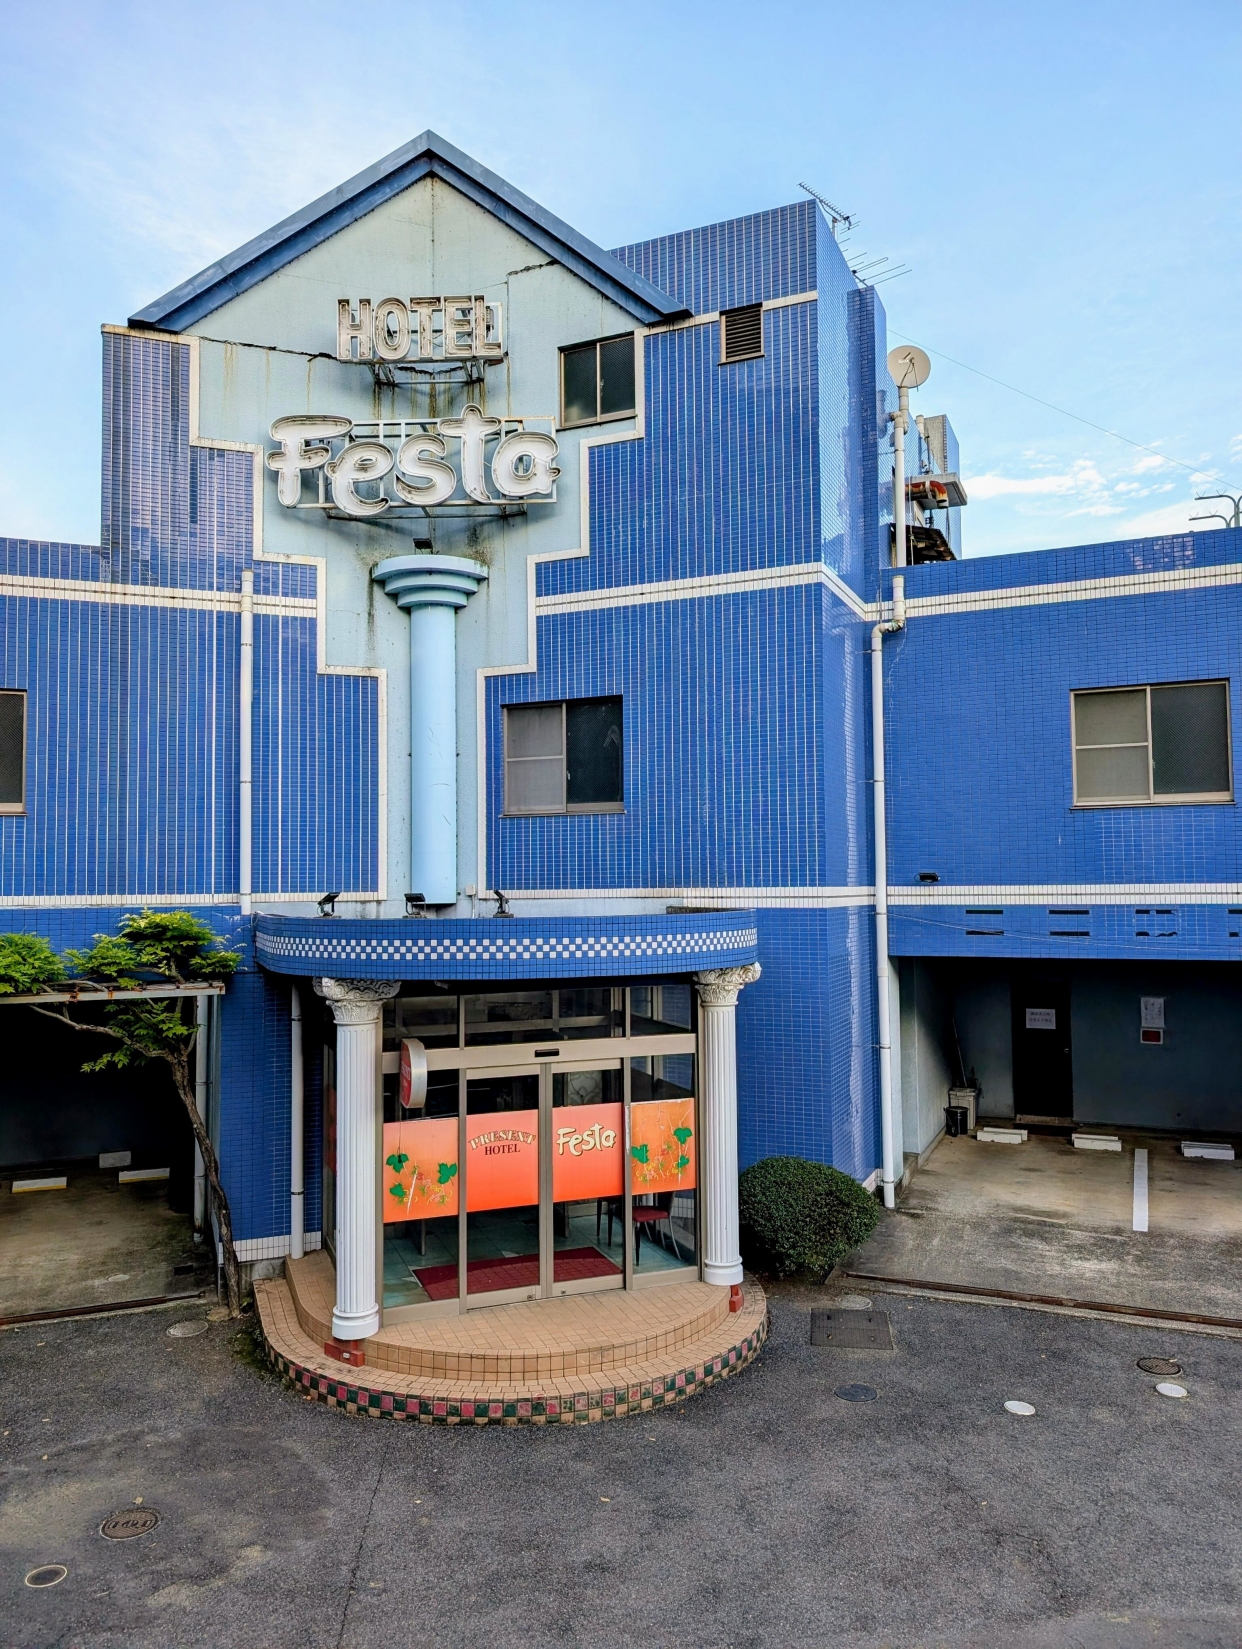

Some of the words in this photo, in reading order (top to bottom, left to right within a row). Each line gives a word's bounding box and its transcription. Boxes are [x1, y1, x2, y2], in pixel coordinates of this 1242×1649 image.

[337, 295, 502, 360] HOTEL
[265, 403, 562, 515] Festa
[468, 1129, 537, 1150] PRESENT
[484, 1143, 521, 1156] HOTEL
[556, 1122, 617, 1157] Festa
